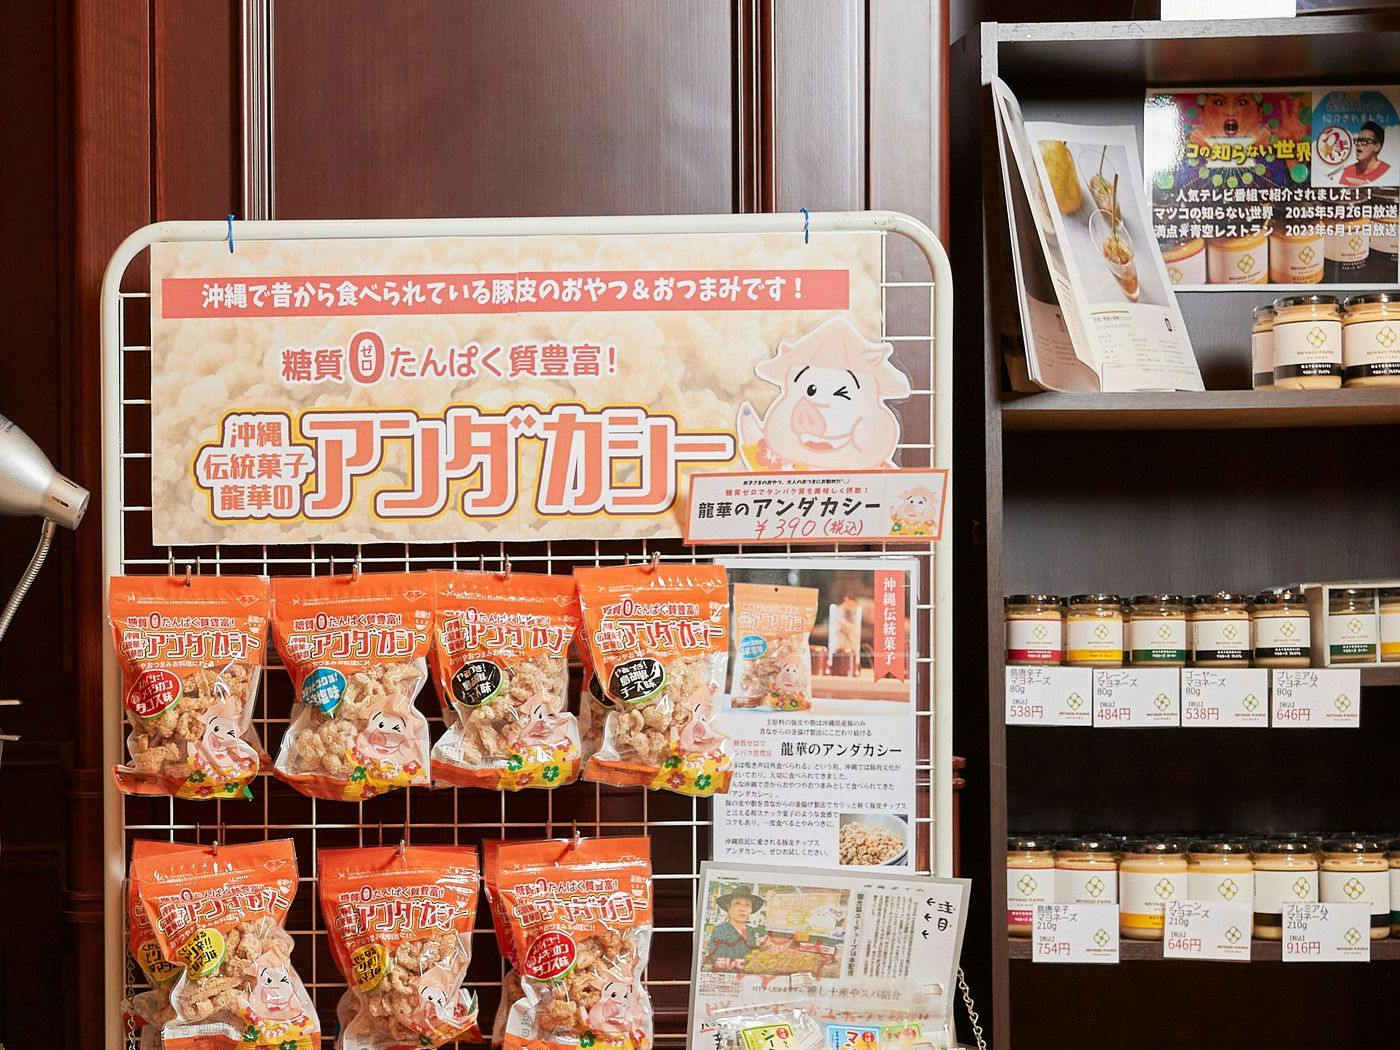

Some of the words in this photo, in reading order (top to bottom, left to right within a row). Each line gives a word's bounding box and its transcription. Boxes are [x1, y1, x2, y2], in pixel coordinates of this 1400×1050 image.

[1176, 188, 1372, 202] 人気テレビ番組で紹介されました！！
[1155, 206, 1273, 220] マツコの知らない世界
[1286, 205, 1398, 219] 2015年5月26日放送
[1286, 223, 1399, 237] 2023年6月17日放送
[202, 278, 806, 310] 沖縄で昔から食べられている豚皮のおやつ＆おつまみです！
[232, 420, 283, 448] 沖縄
[202, 453, 307, 481] 伝統菓子
[306, 411, 735, 513] アンダカシー
[221, 482, 293, 512] 龍華の
[699, 498, 880, 519] 龍華のアンダカシー
[882, 577, 897, 666] 沖縄伝統菓子
[626, 620, 723, 648] アンダカシー
[146, 630, 261, 660] アンダカシー
[312, 628, 427, 656] アンダカシー
[1011, 677, 1051, 685] マヨネーズ
[1098, 680, 1138, 688] マヨネーズ
[1186, 679, 1226, 687] マヨネーズ
[1097, 688, 1112, 696] 80g
[1277, 688, 1292, 696] 80g
[1010, 706, 1043, 718] 538円
[1098, 708, 1130, 720] 484円
[1186, 708, 1219, 720] 538円
[1277, 708, 1310, 721] 646円
[781, 742, 901, 757] 龍華のアンダカシー
[937, 902, 954, 931] 注目
[1169, 910, 1209, 918] マヨネーズ
[1037, 922, 1056, 930] 210g
[1169, 918, 1189, 927] 210g
[1287, 922, 1307, 930] 210g
[1038, 942, 1070, 955] 754円
[1168, 939, 1201, 951] 646円
[1287, 942, 1320, 955] 916円
